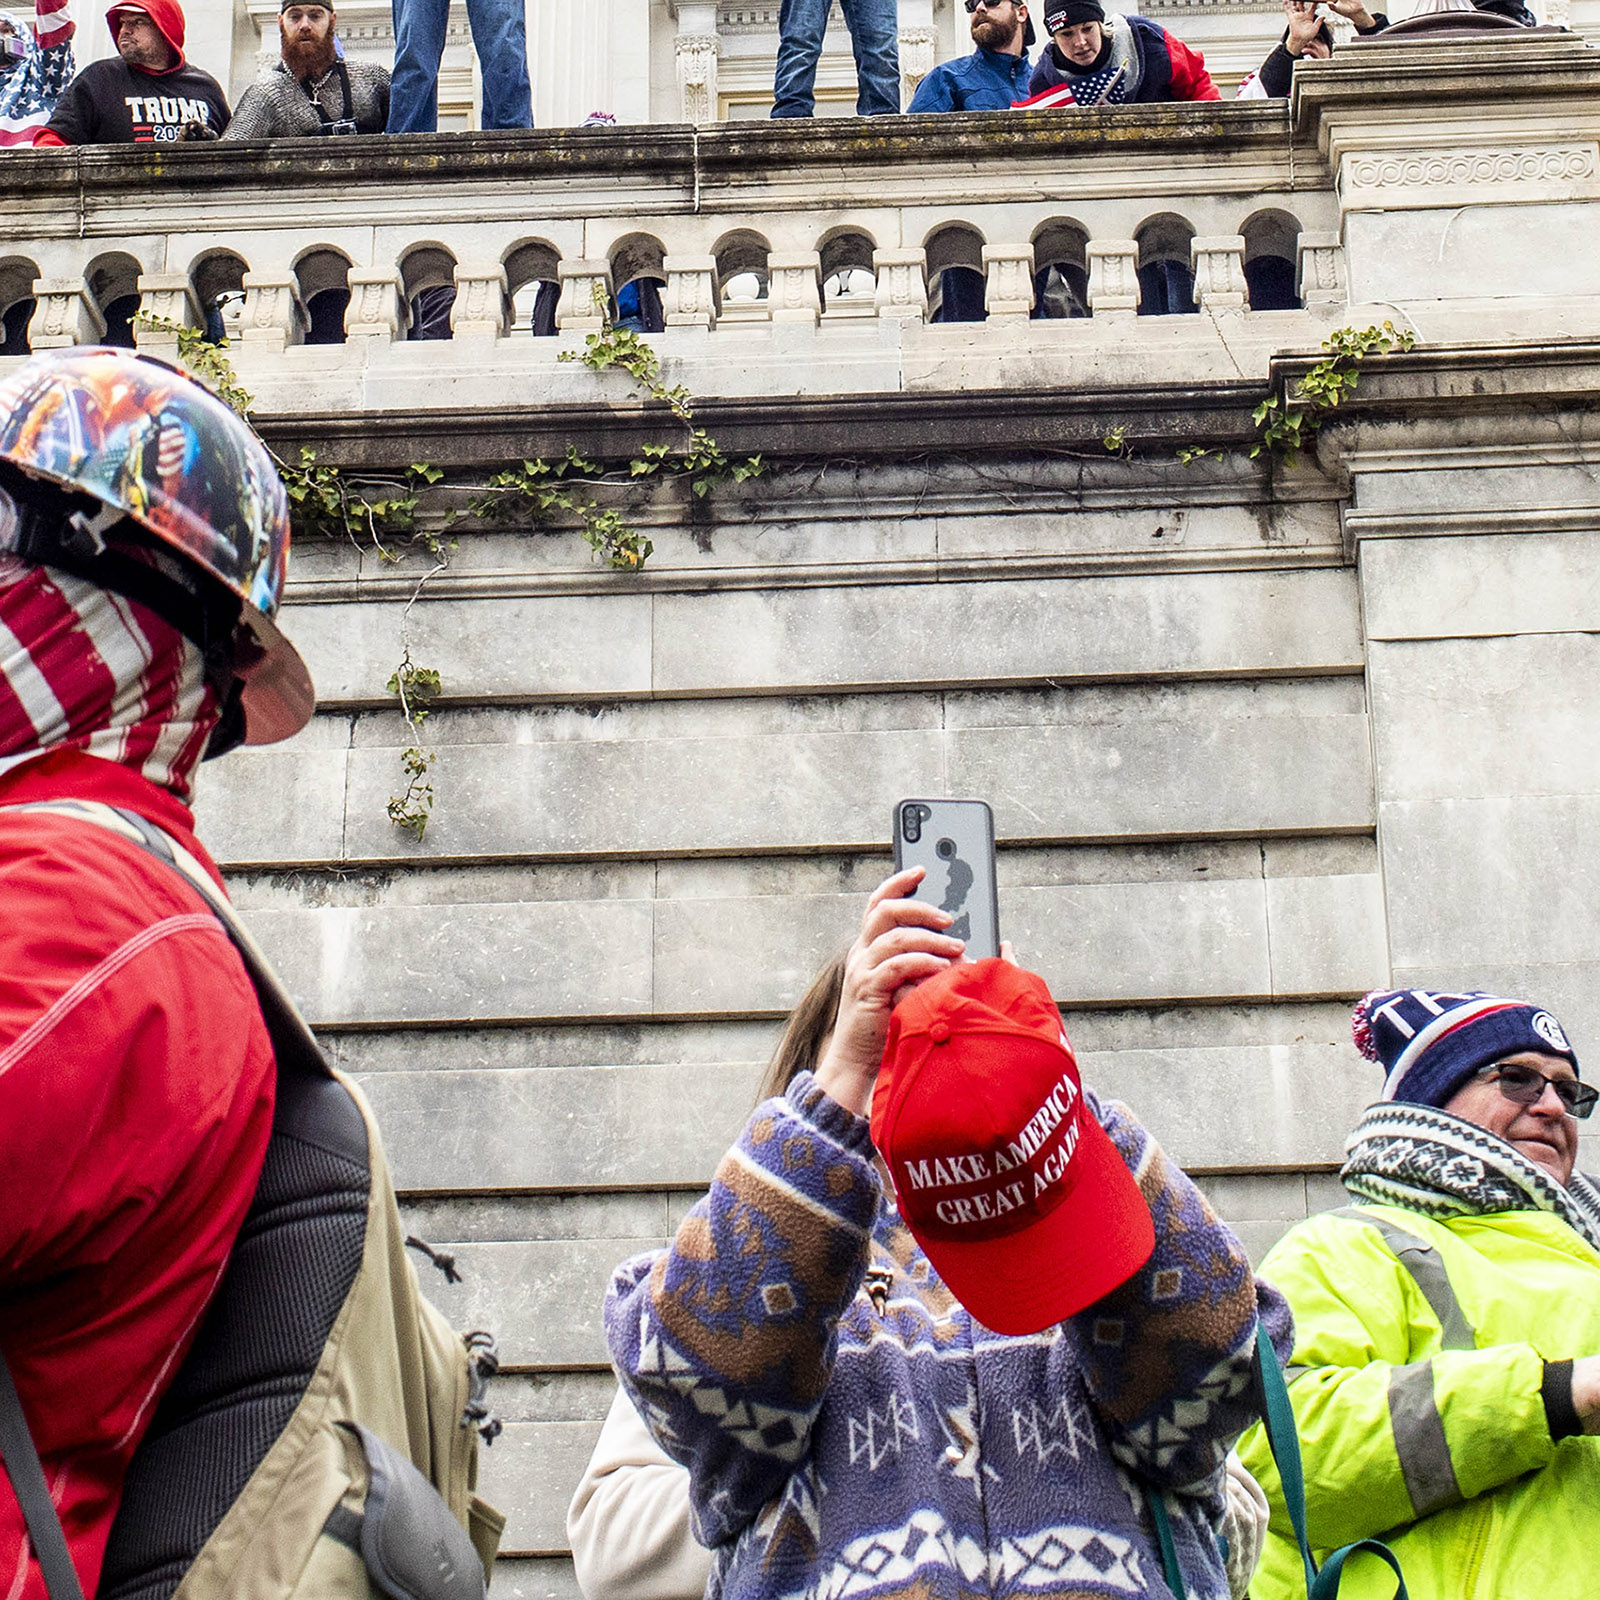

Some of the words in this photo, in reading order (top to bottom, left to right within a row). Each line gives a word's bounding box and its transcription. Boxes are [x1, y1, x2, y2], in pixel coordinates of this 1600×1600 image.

[124, 96, 211, 126] TRUMP
[153, 124, 182, 143] 20
[903, 1152, 991, 1190] MAKE
[995, 1073, 1079, 1175] AMERICA
[935, 1180, 1028, 1225] GREAT
[1034, 1116, 1080, 1198] AGAIN
